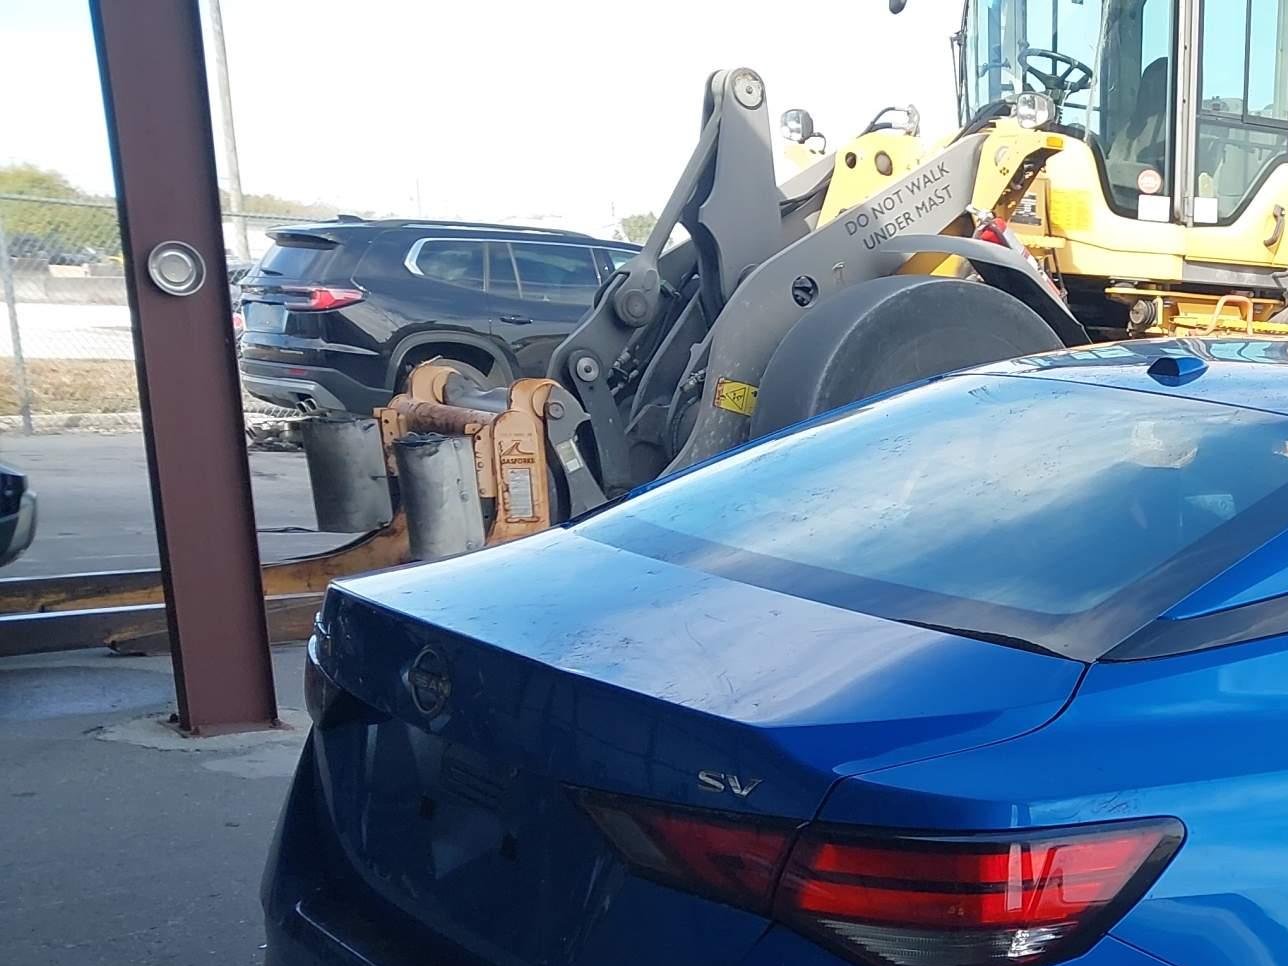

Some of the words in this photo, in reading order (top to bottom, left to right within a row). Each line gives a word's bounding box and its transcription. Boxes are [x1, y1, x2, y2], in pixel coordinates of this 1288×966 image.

[845, 213, 870, 236] DO
[871, 189, 903, 220] NOT
[905, 161, 950, 196] WALK
[863, 211, 915, 250] UNDER
[915, 184, 952, 218] MAST
[698, 770, 764, 798] SV
